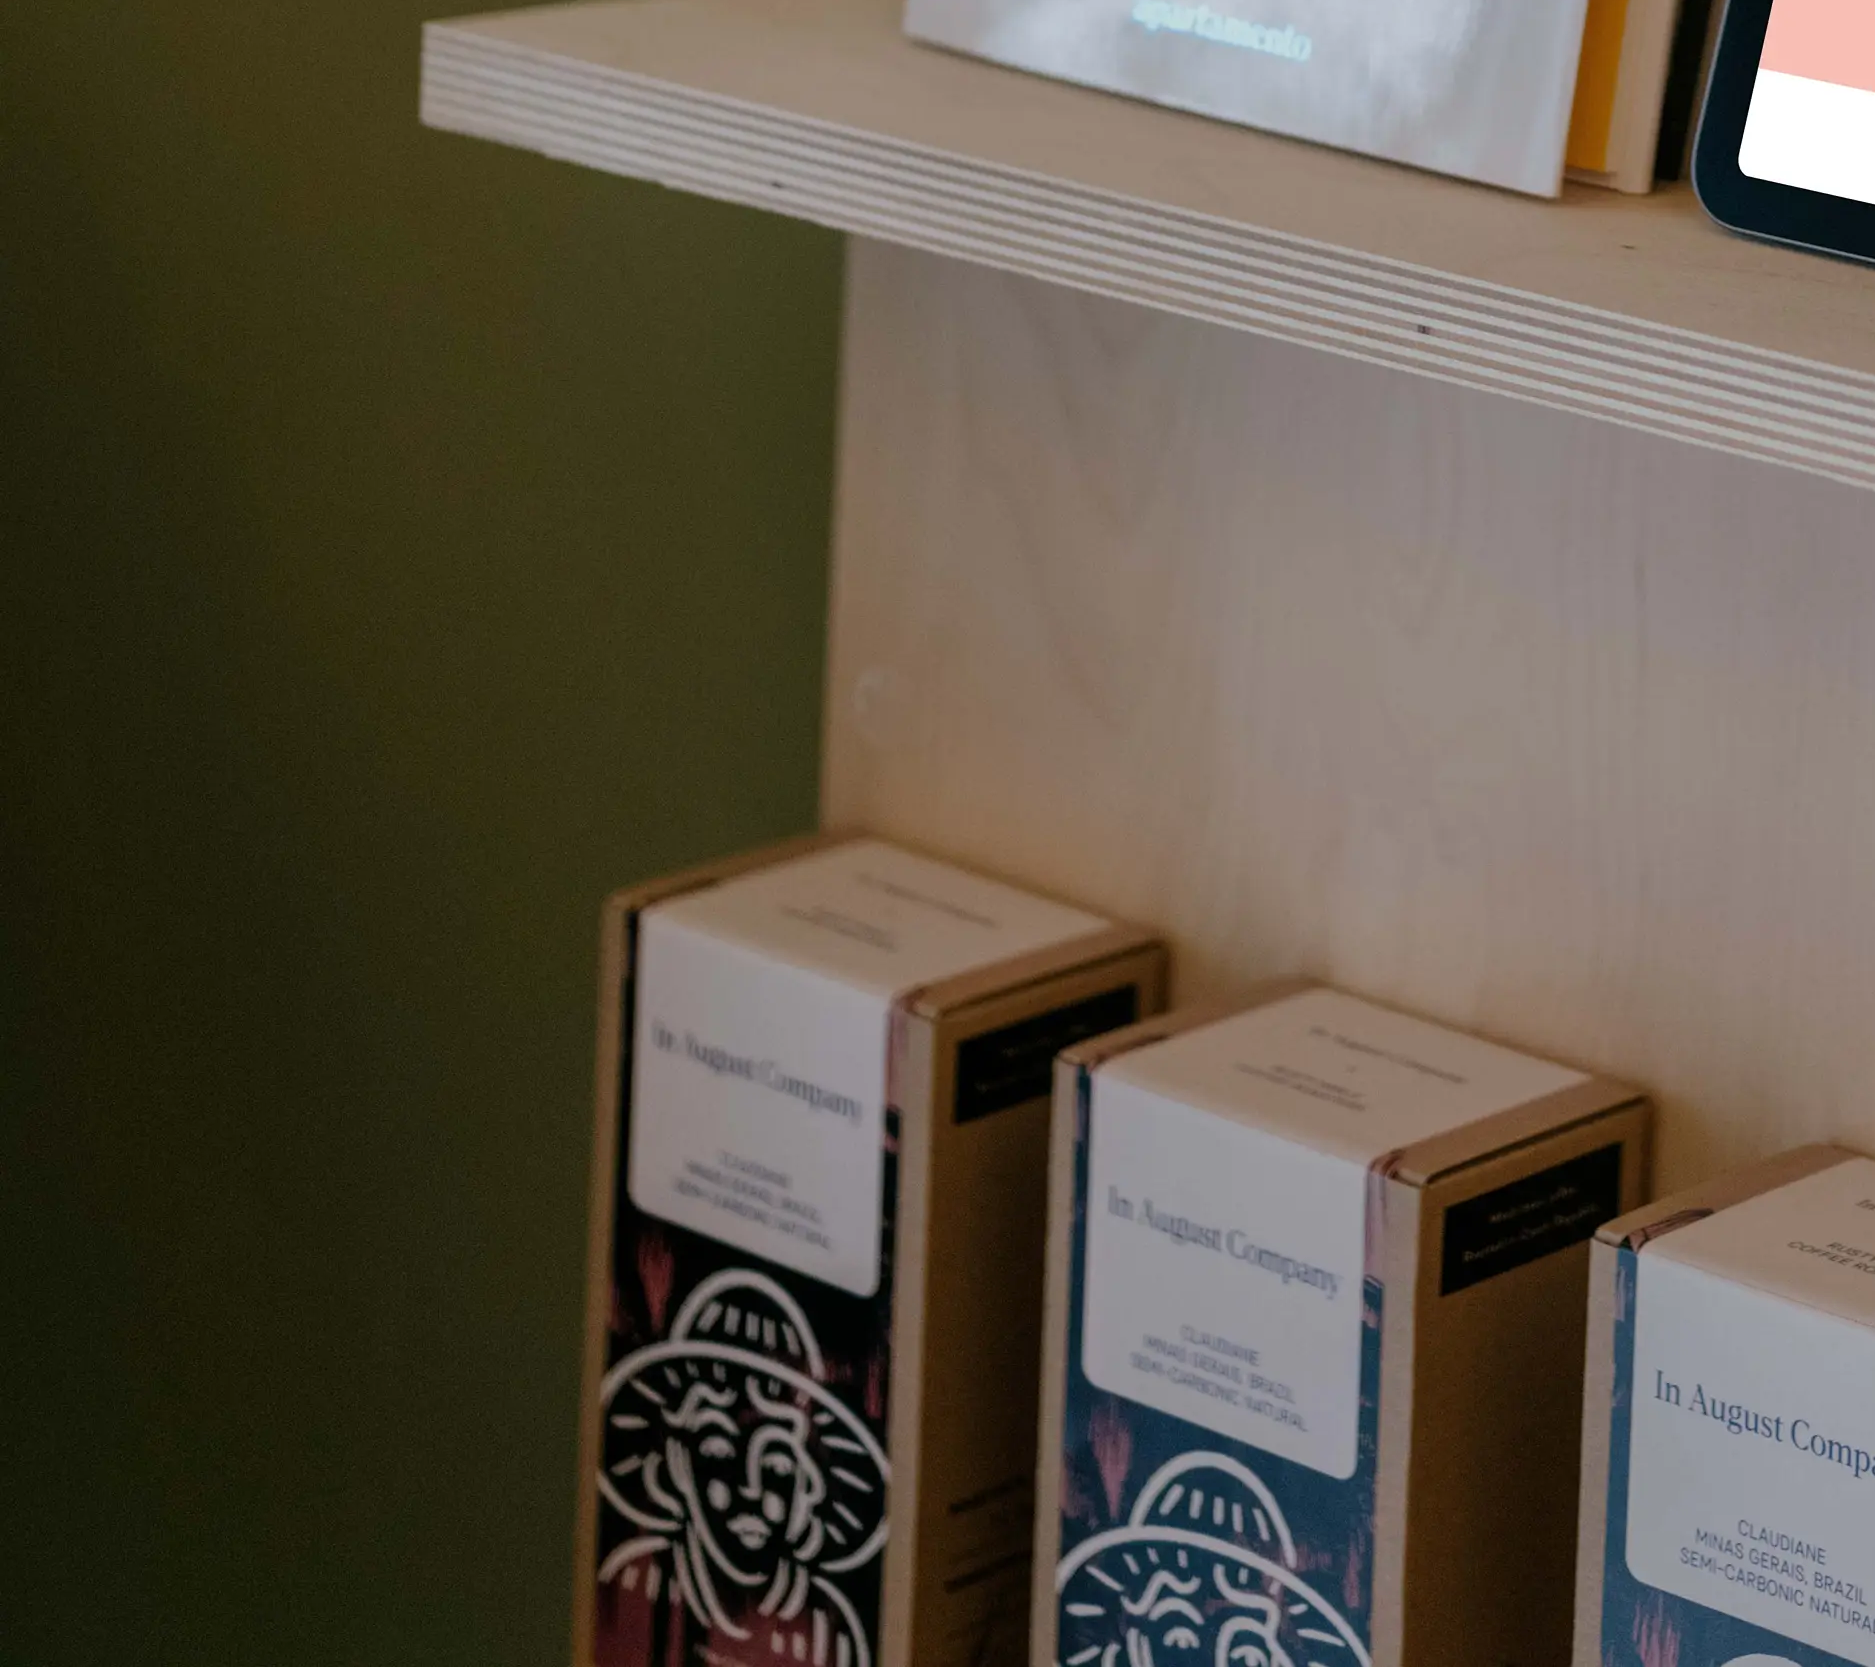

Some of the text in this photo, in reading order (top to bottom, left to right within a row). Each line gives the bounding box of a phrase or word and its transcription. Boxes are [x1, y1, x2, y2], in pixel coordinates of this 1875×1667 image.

[1107, 1184, 1345, 1301] In August Company
[1786, 1240, 1853, 1267] COFFEE
[1653, 1368, 1682, 1408] In
[1687, 1383, 1784, 1443] August
[1694, 1527, 1744, 1561] MINAS
[1813, 1570, 1869, 1607] BRAZIL
[1737, 1518, 1828, 1566] CLAUDIANE
[1679, 1546, 1805, 1608] SEMI-CARBONIC
